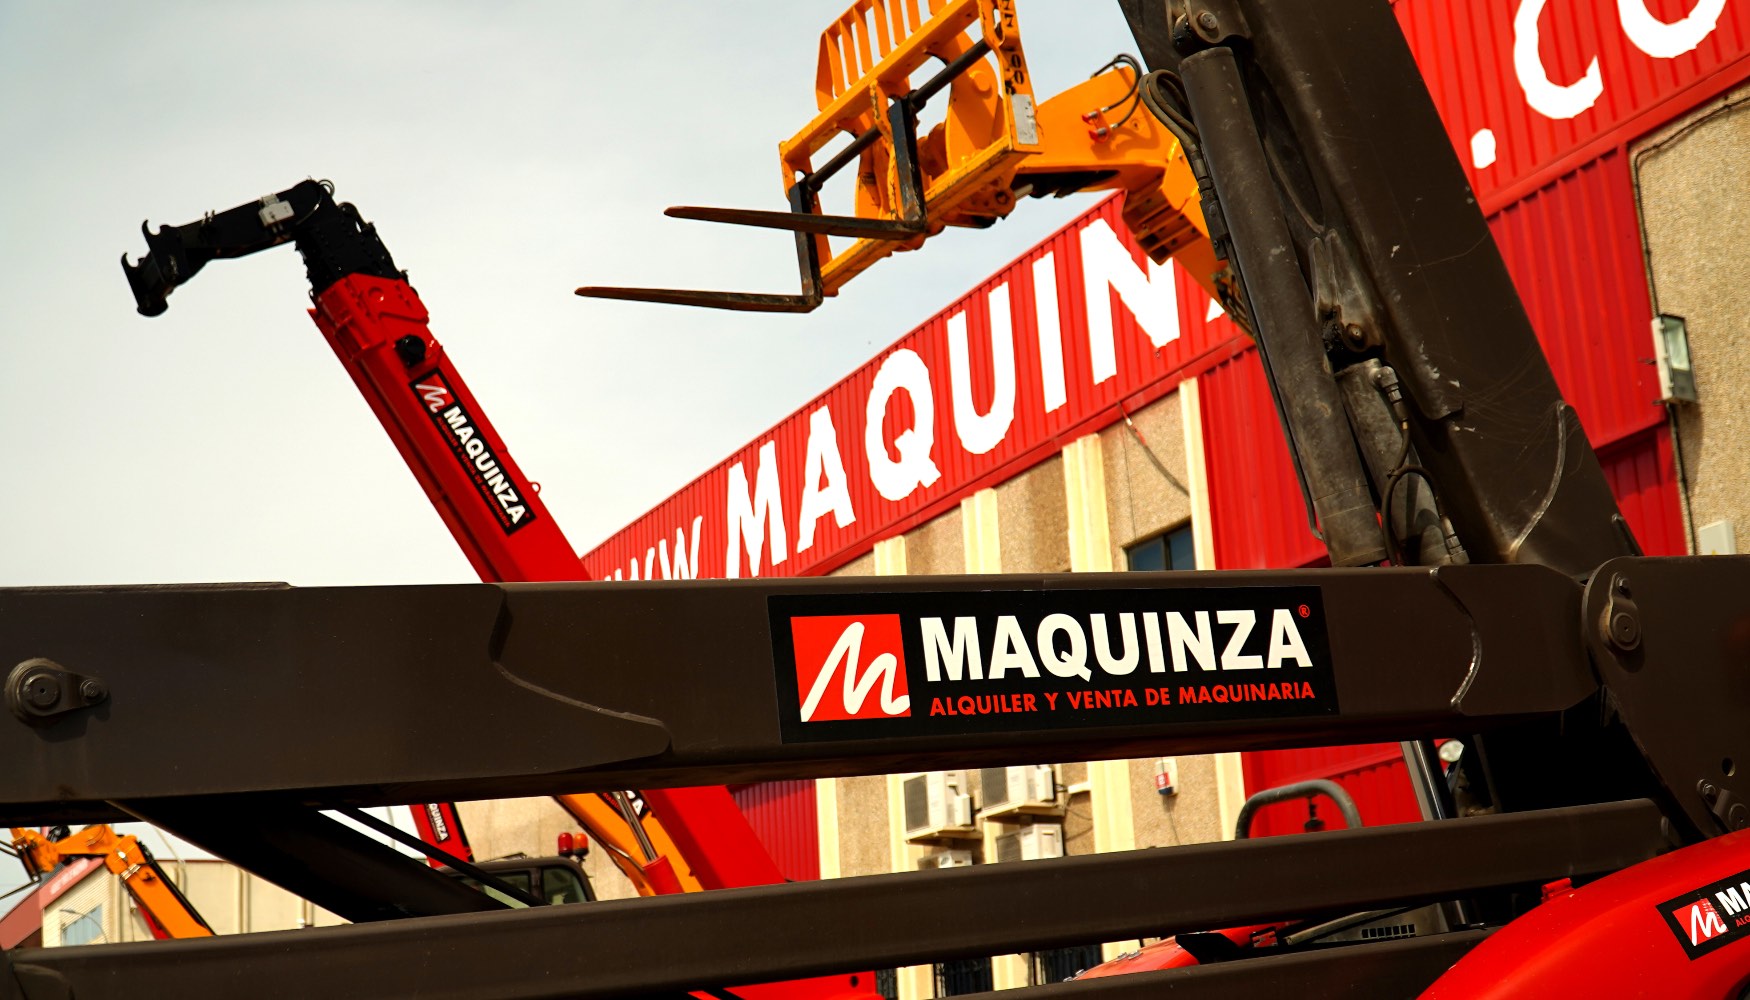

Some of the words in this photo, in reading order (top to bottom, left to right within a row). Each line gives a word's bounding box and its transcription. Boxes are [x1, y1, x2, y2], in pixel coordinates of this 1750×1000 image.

[726, 218, 1227, 579] MAQUIN
[443, 406, 525, 524] MAQUINZA
[920, 609, 1314, 682] MAQUINZA
[930, 693, 1038, 717] ALQUILER
[1045, 692, 1059, 711] Y
[1066, 688, 1139, 710] VENTA
[1145, 687, 1171, 707] DE
[1179, 681, 1316, 704] MAQUINARIA
